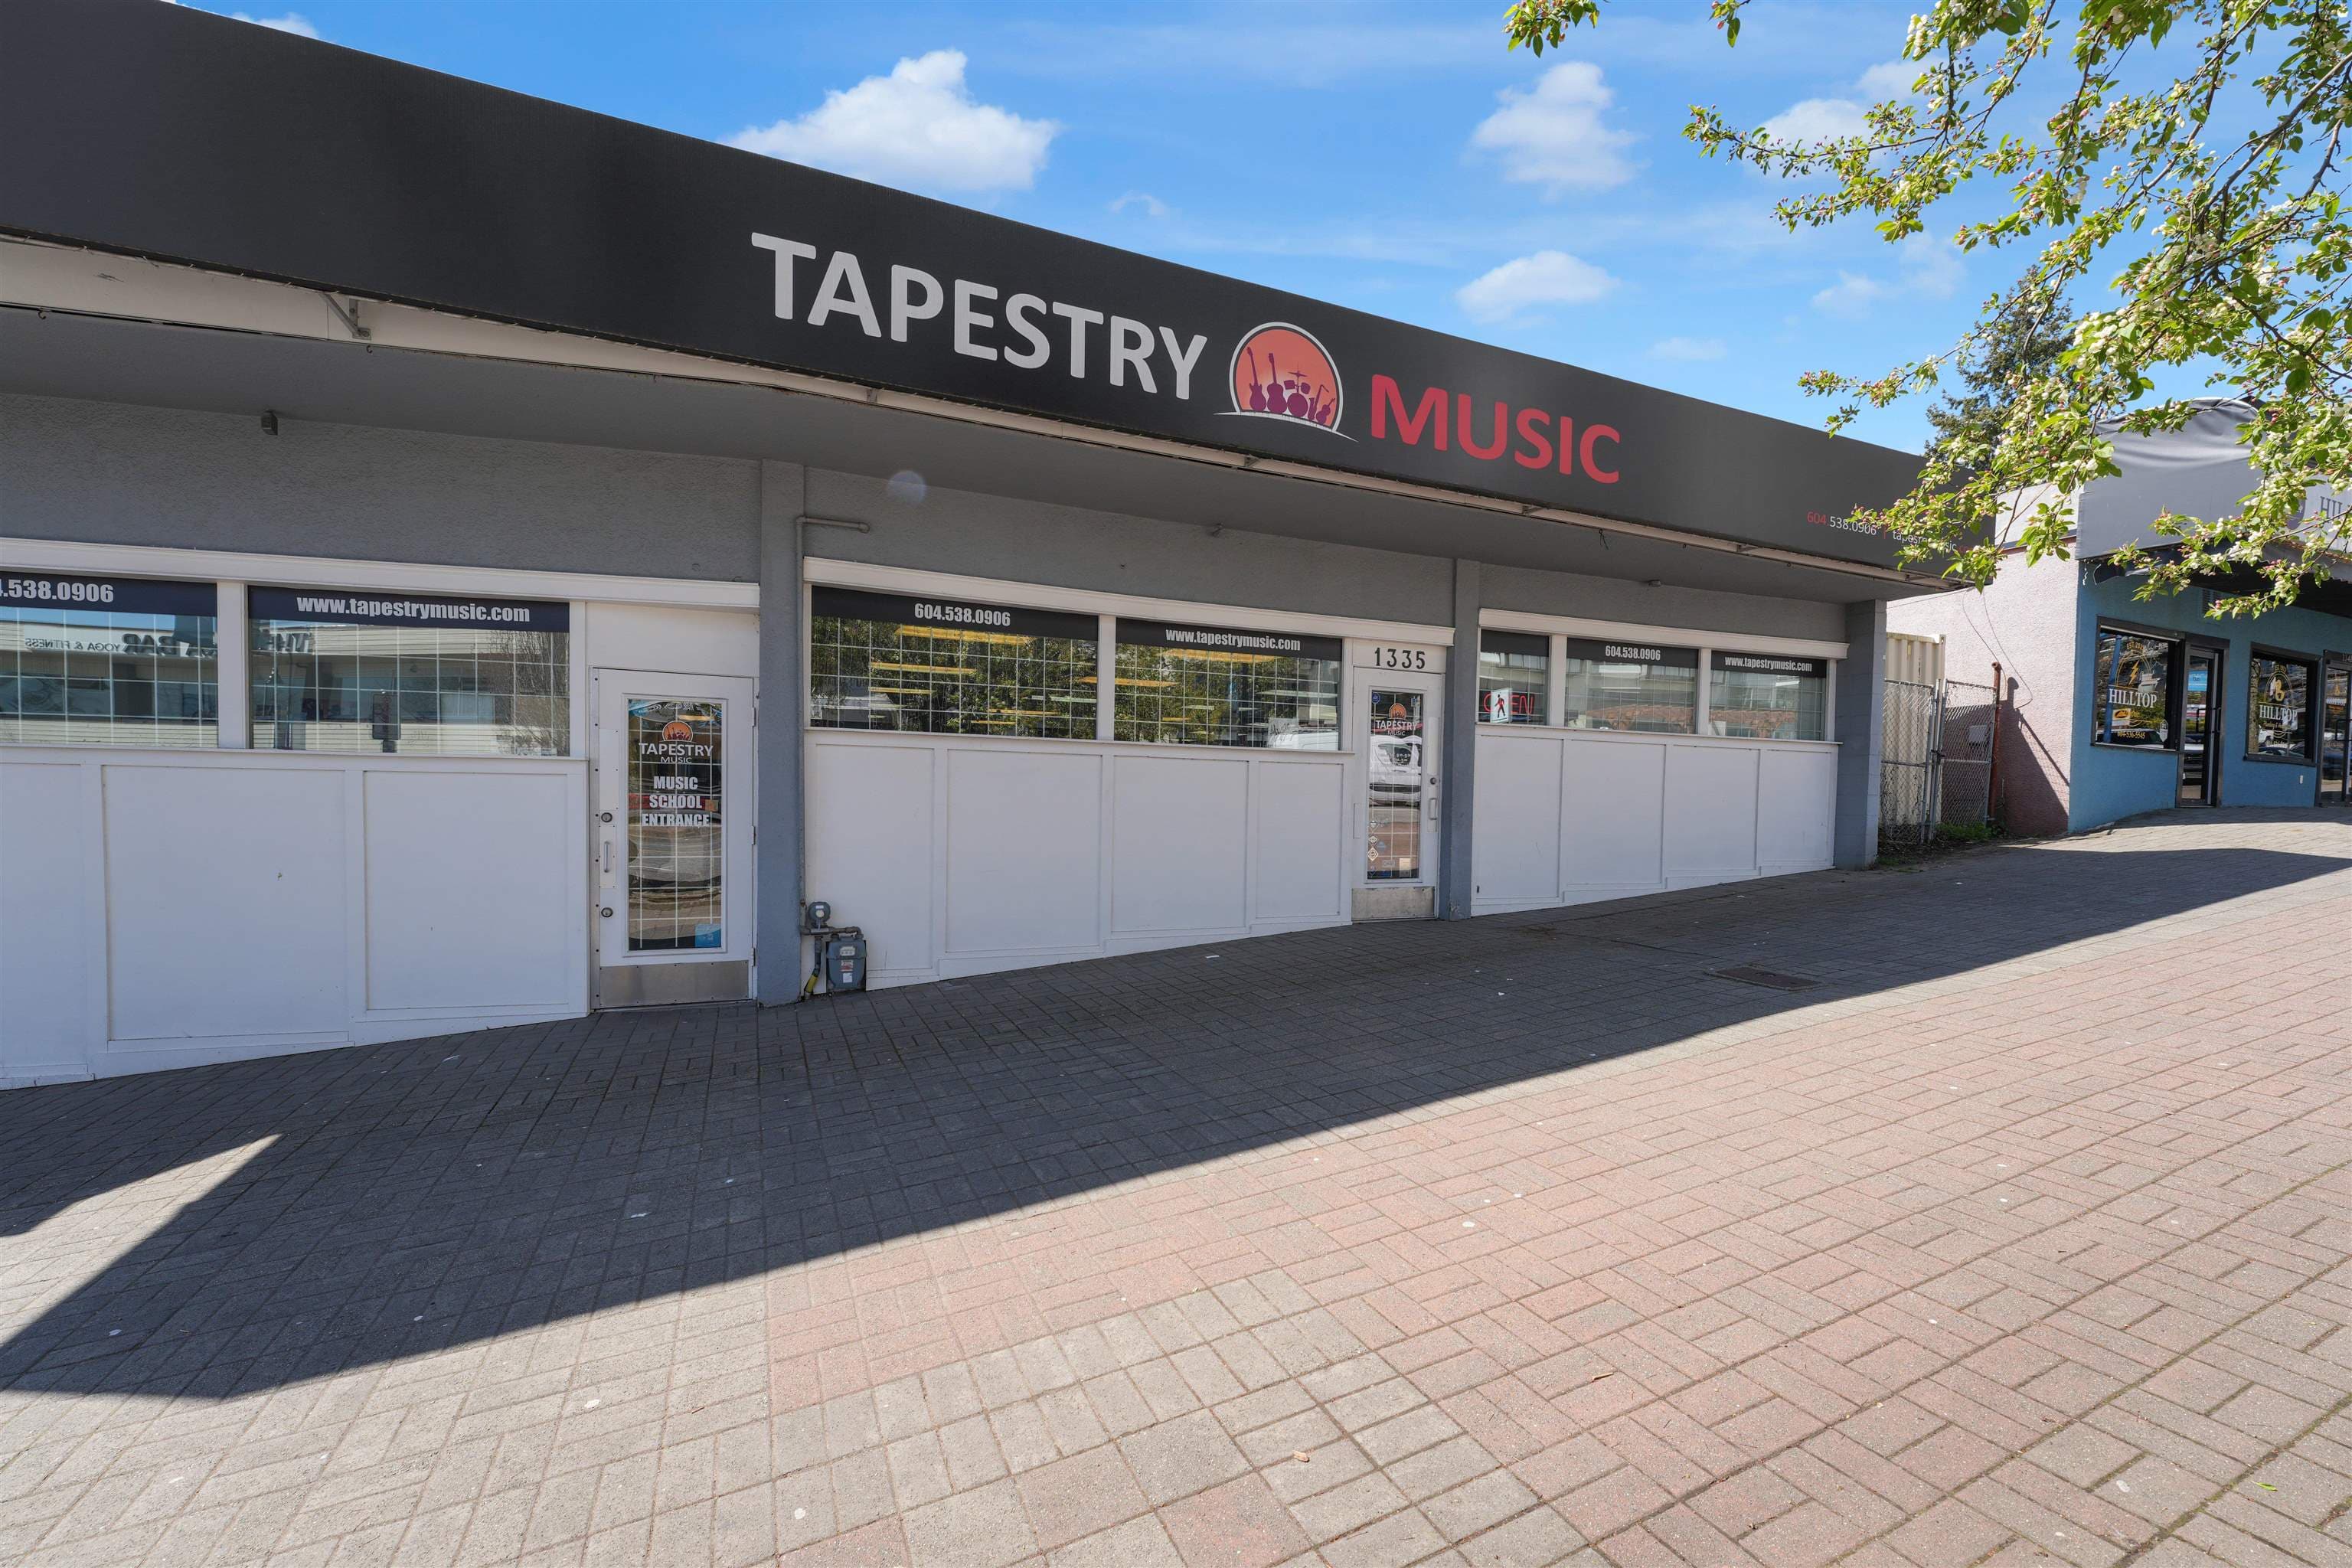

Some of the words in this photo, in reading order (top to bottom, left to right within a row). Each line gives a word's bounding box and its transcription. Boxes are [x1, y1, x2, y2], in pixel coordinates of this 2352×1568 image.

[751, 232, 1207, 400] TAPESTRY
[1371, 374, 1620, 484] MUSIC
[296, 596, 531, 622] www.tapestrymusic.com
[914, 603, 1011, 627] 604.538.0906
[1165, 629, 1301, 652] www.tapestrymusic.com
[1374, 647, 1426, 670] 1335
[1605, 645, 1661, 662] 604.538.0906
[1725, 655, 1812, 673] www.tapestrymusic.com
[2109, 688, 2158, 708] HILLTOP
[2259, 704, 2297, 721] HILLTOP
[1375, 720, 1417, 730] TAPESTRY
[639, 743, 714, 756] TAPESTRY
[653, 776, 698, 790] MUSIC
[649, 795, 703, 808] SCHOOL
[642, 813, 710, 827] ENTRANCE
